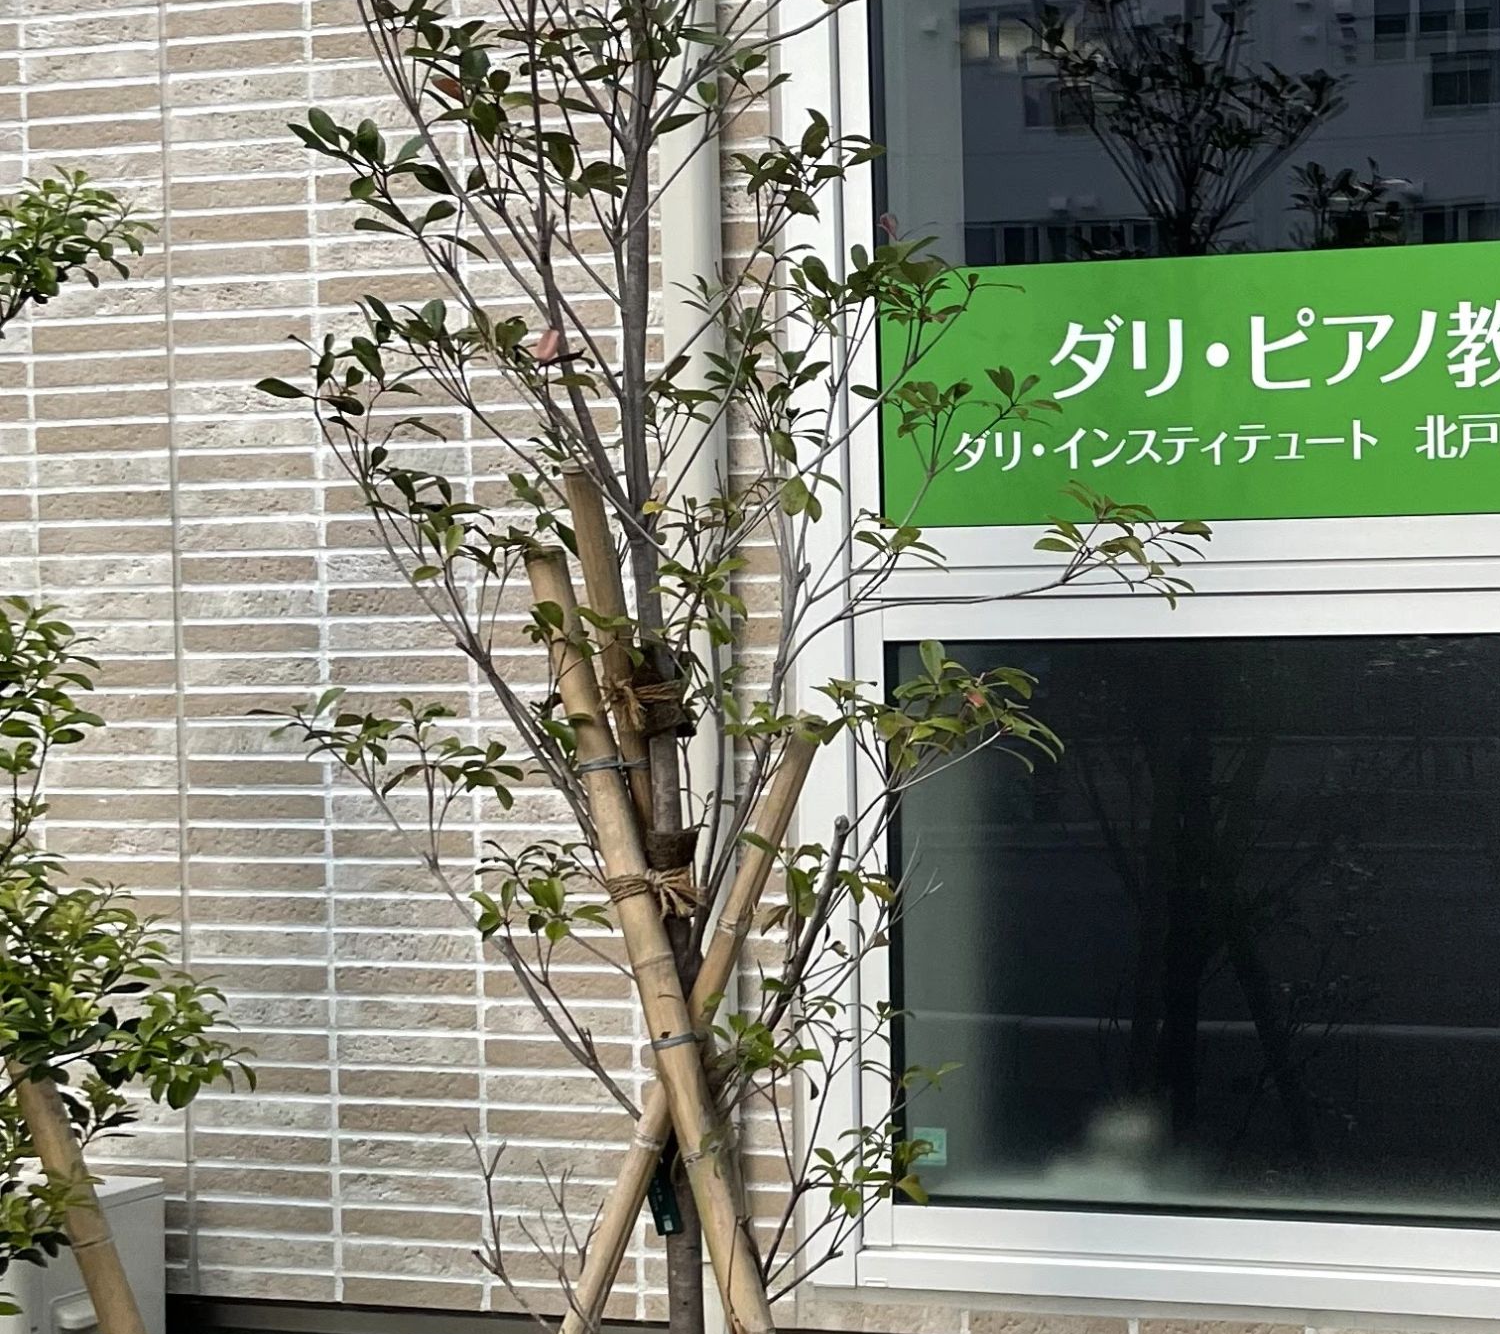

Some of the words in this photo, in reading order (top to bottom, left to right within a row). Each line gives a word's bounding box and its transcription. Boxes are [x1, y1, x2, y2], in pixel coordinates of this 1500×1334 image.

[952, 419, 1380, 472] ダリ・インスティテュート
